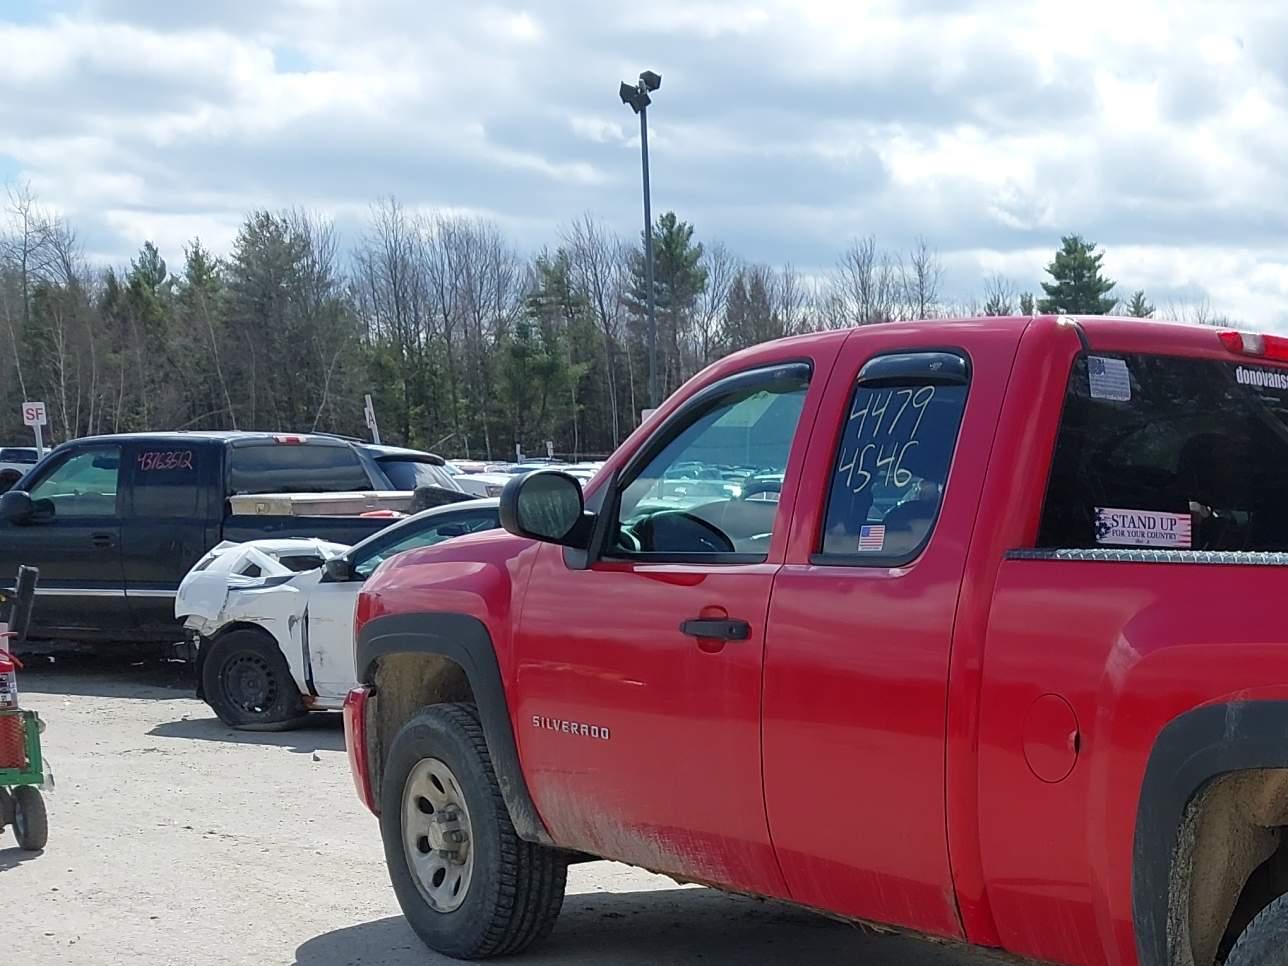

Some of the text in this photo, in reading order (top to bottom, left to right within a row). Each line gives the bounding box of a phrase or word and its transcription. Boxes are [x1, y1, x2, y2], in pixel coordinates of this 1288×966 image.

[25, 407, 44, 421] SF
[849, 385, 936, 440] 4479
[838, 440, 920, 494] 4546
[1111, 513, 1177, 531] STAND UP
[1111, 528, 1177, 540] FOR YOUR COUNTRY
[532, 715, 610, 740] SILVERADO
